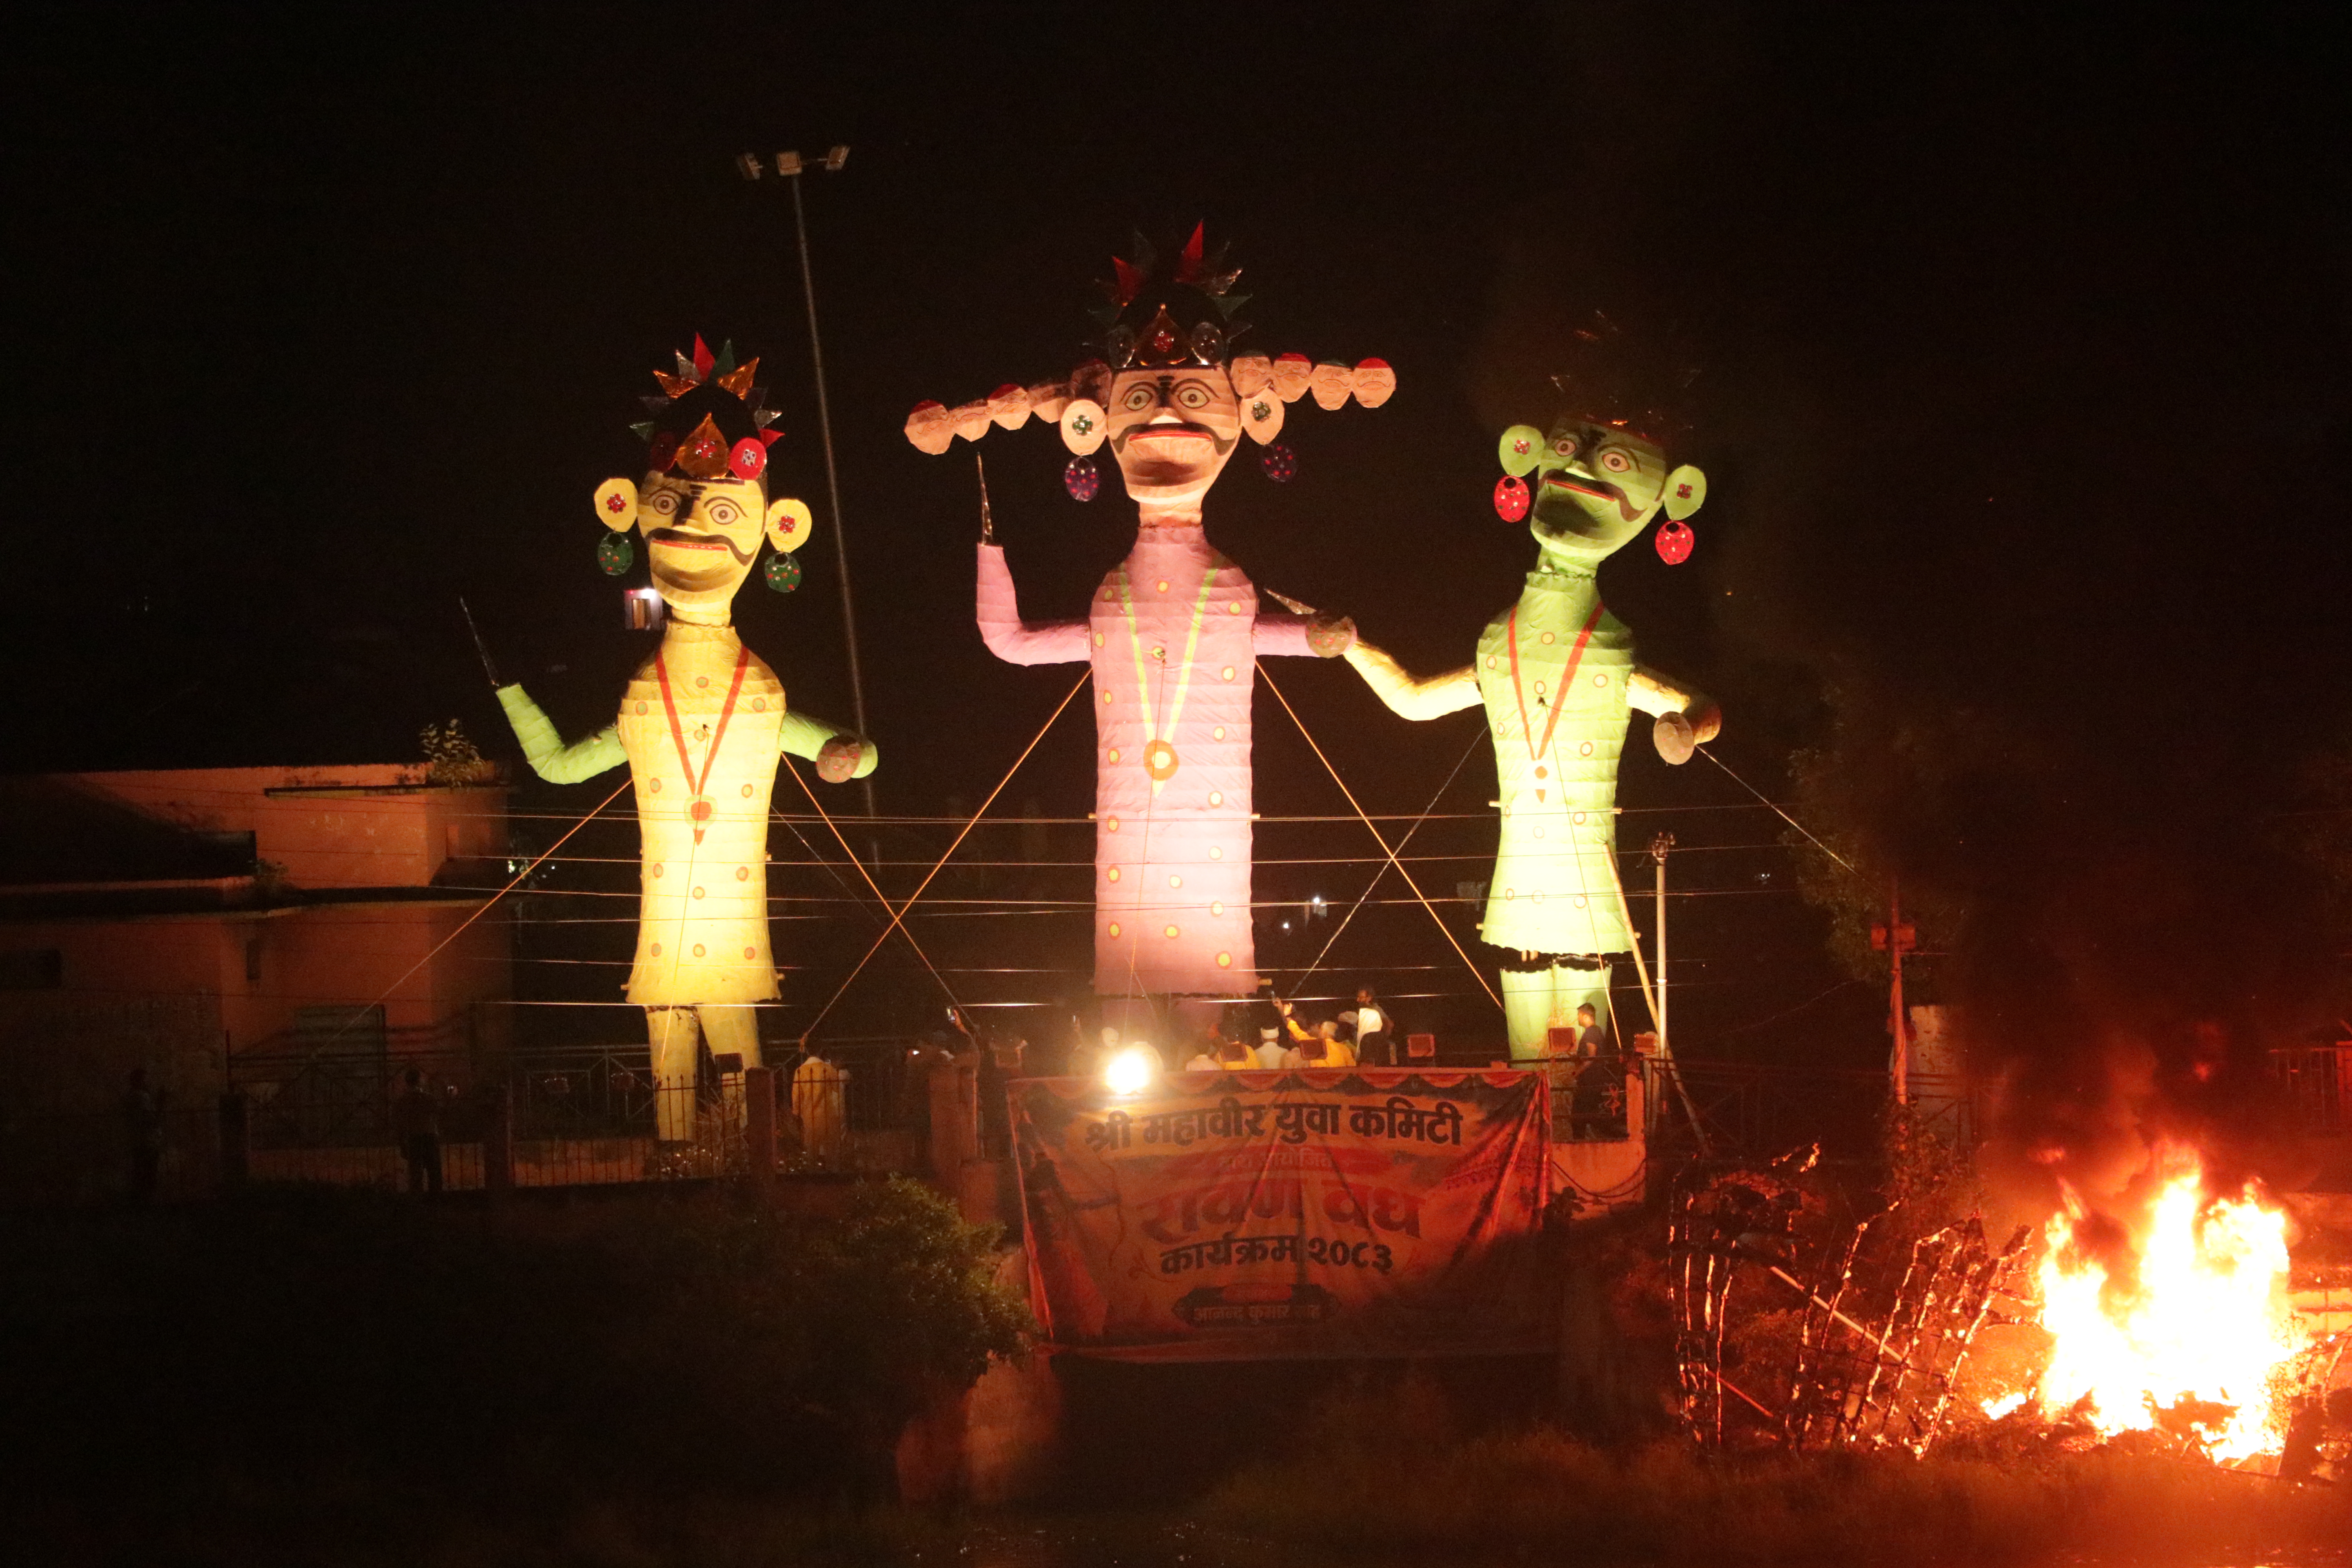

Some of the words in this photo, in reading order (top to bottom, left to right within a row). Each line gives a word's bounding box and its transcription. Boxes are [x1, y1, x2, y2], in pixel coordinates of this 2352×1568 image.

[1085, 1111, 1132, 1152] श्री
[1142, 1097, 1267, 1146] महावीर
[1275, 1102, 1340, 1144] युवा
[1350, 1097, 1463, 1145] कमिटी
[1137, 1178, 1303, 1244] रावण
[1321, 1179, 1426, 1238] वध
[1160, 1231, 1300, 1274] कार्यक्रम
[1307, 1237, 1393, 1275] २०८३
